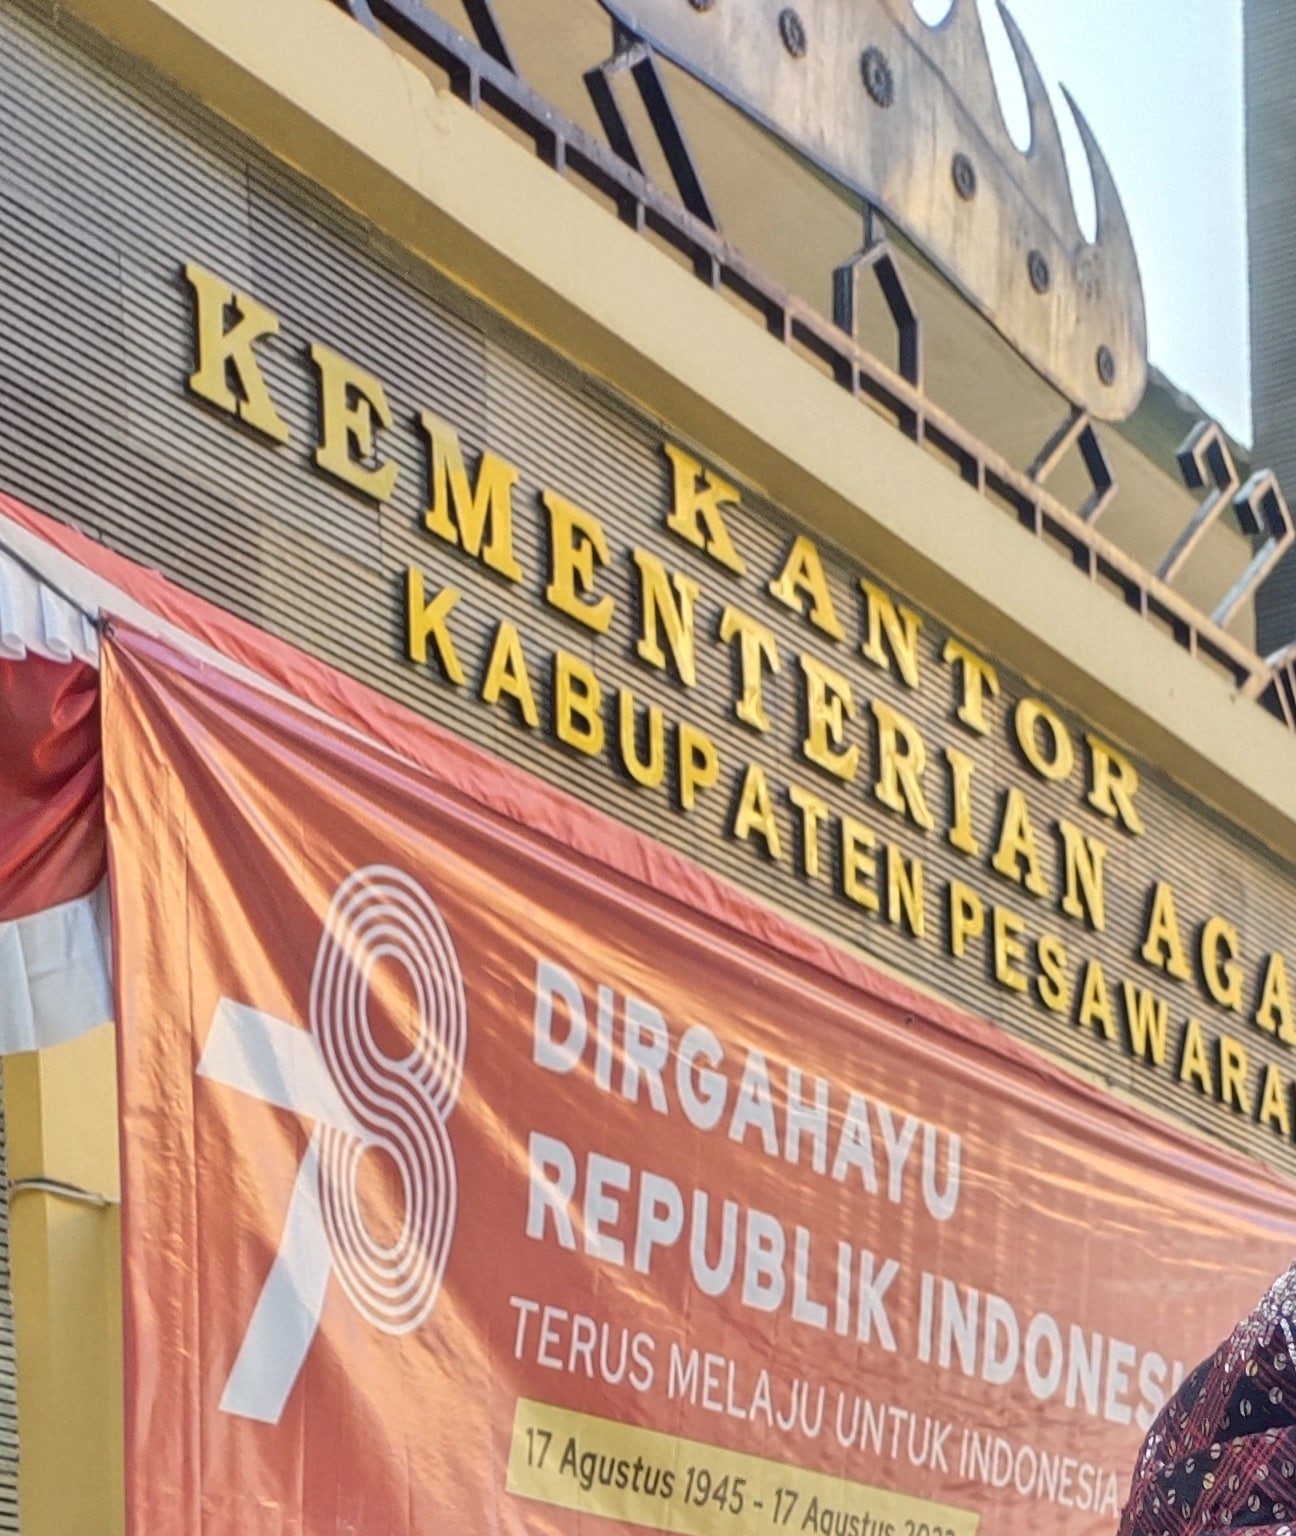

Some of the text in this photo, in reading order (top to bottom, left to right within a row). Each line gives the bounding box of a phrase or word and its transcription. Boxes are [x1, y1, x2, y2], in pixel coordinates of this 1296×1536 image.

[184, 263, 1107, 931] KEMENTERIAN
[664, 443, 1146, 834] KANTOR
[406, 565, 926, 940] KABUPATEN
[532, 958, 962, 1220] DIRGAHAYU
[525, 1130, 900, 1352] REPUBLIK
[509, 1296, 1122, 1516] TERUS MELAJU UNTUK INDONESIA
[525, 1426, 553, 1470] 17
[559, 1437, 675, 1499] Agustus
[683, 1464, 746, 1515] 1945
[770, 1485, 798, 1526] 17
